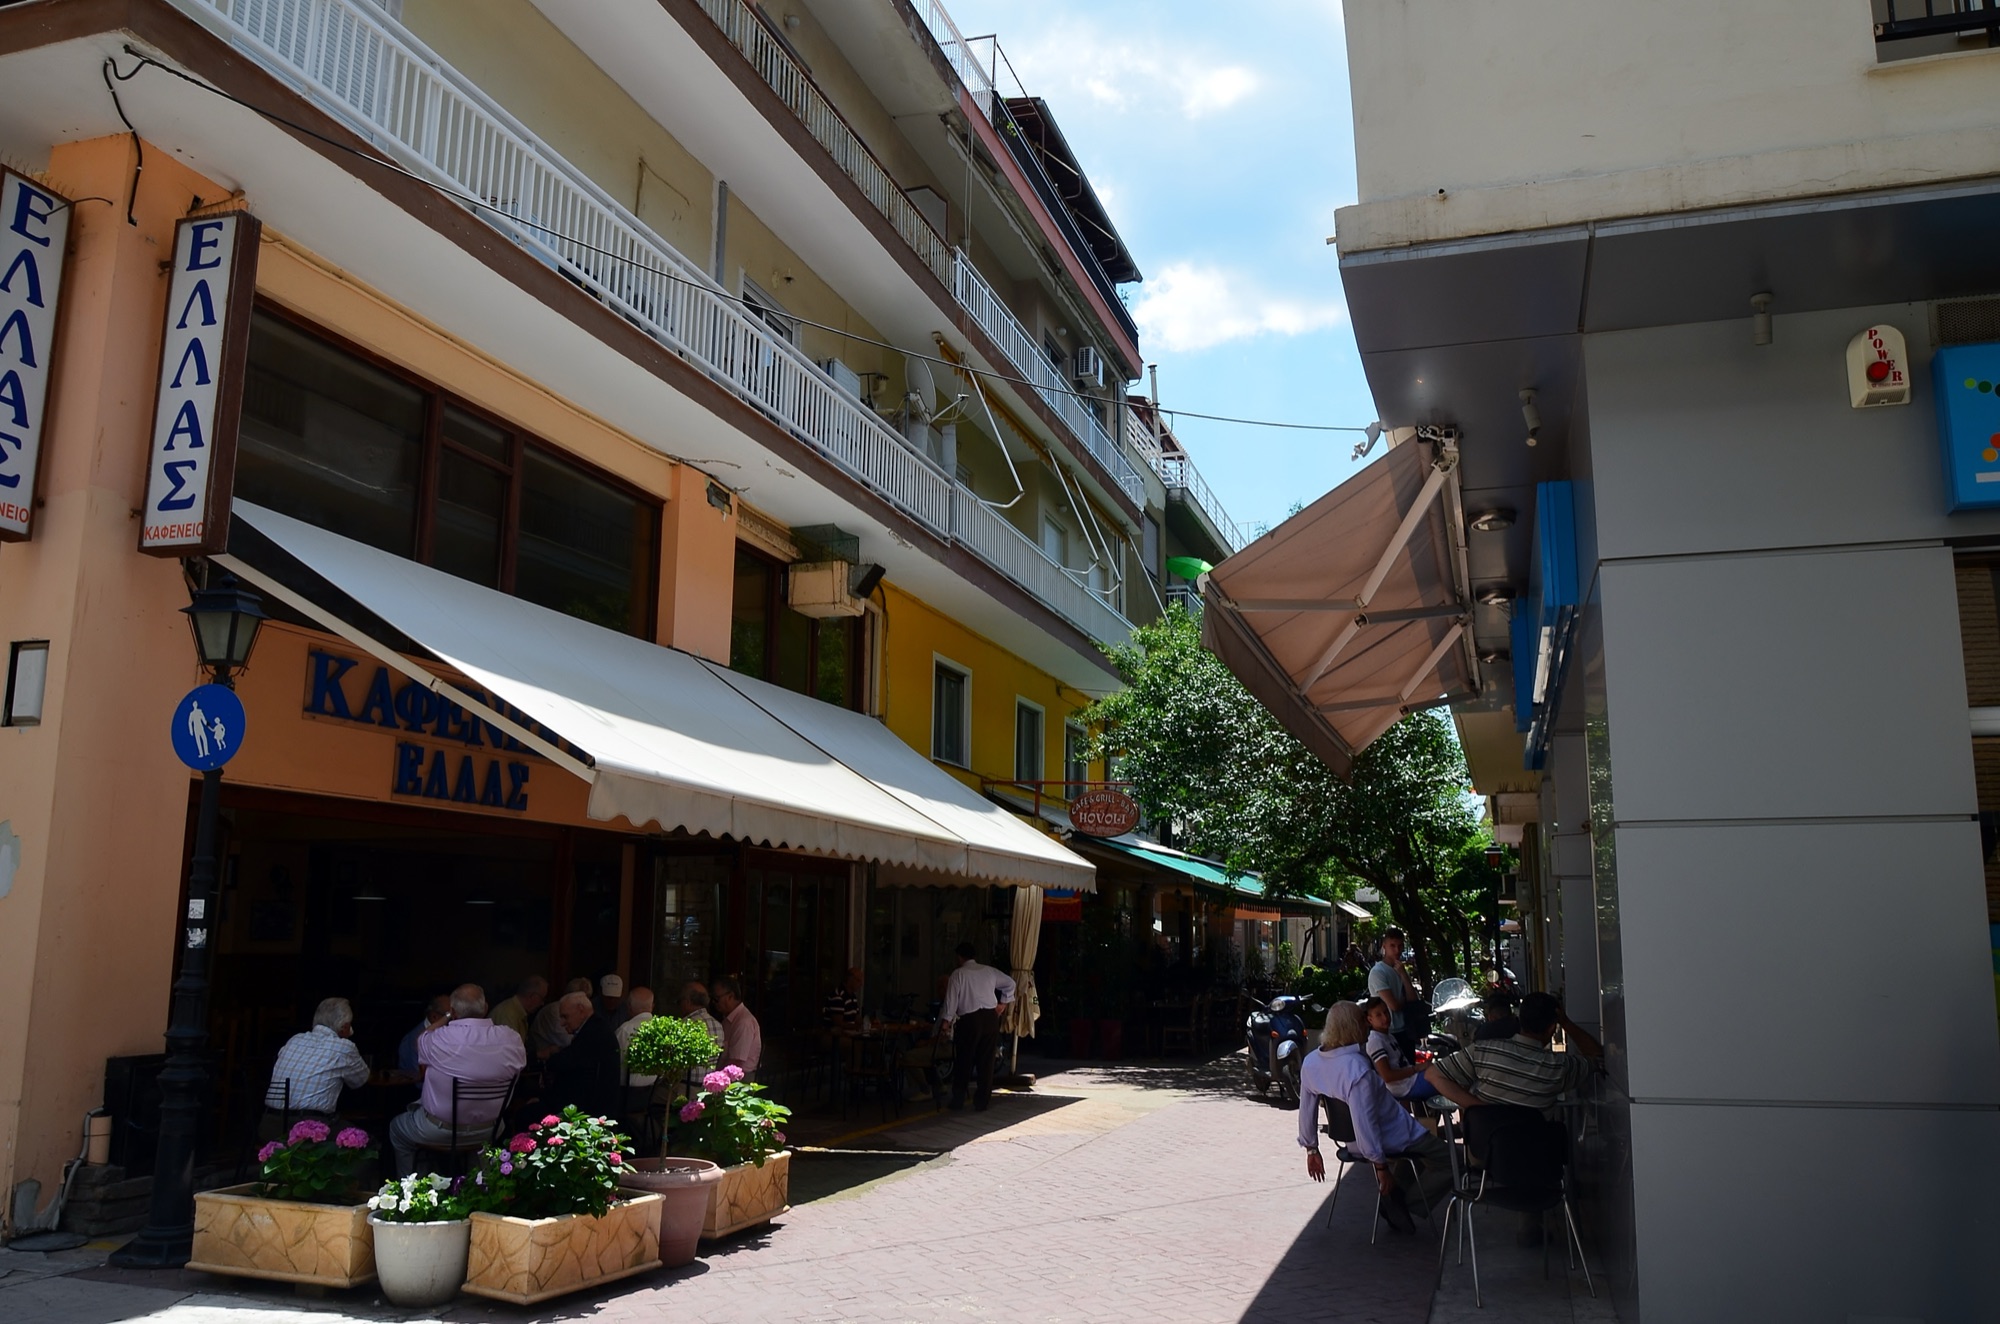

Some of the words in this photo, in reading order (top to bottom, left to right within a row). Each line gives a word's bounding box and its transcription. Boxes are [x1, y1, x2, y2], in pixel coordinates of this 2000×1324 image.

[157, 221, 223, 511] ΕΛΛΑΣ
[1867, 329, 1903, 382] POWER
[144, 522, 204, 541] ΚΑΦΕΝΕΙΟ
[304, 651, 590, 762] ΚΑΦΕΝ
[393, 742, 530, 811] ΕΛΛΑΣ
[1095, 793, 1115, 804] GRILL
[1079, 810, 1127, 825] HOVOLI
